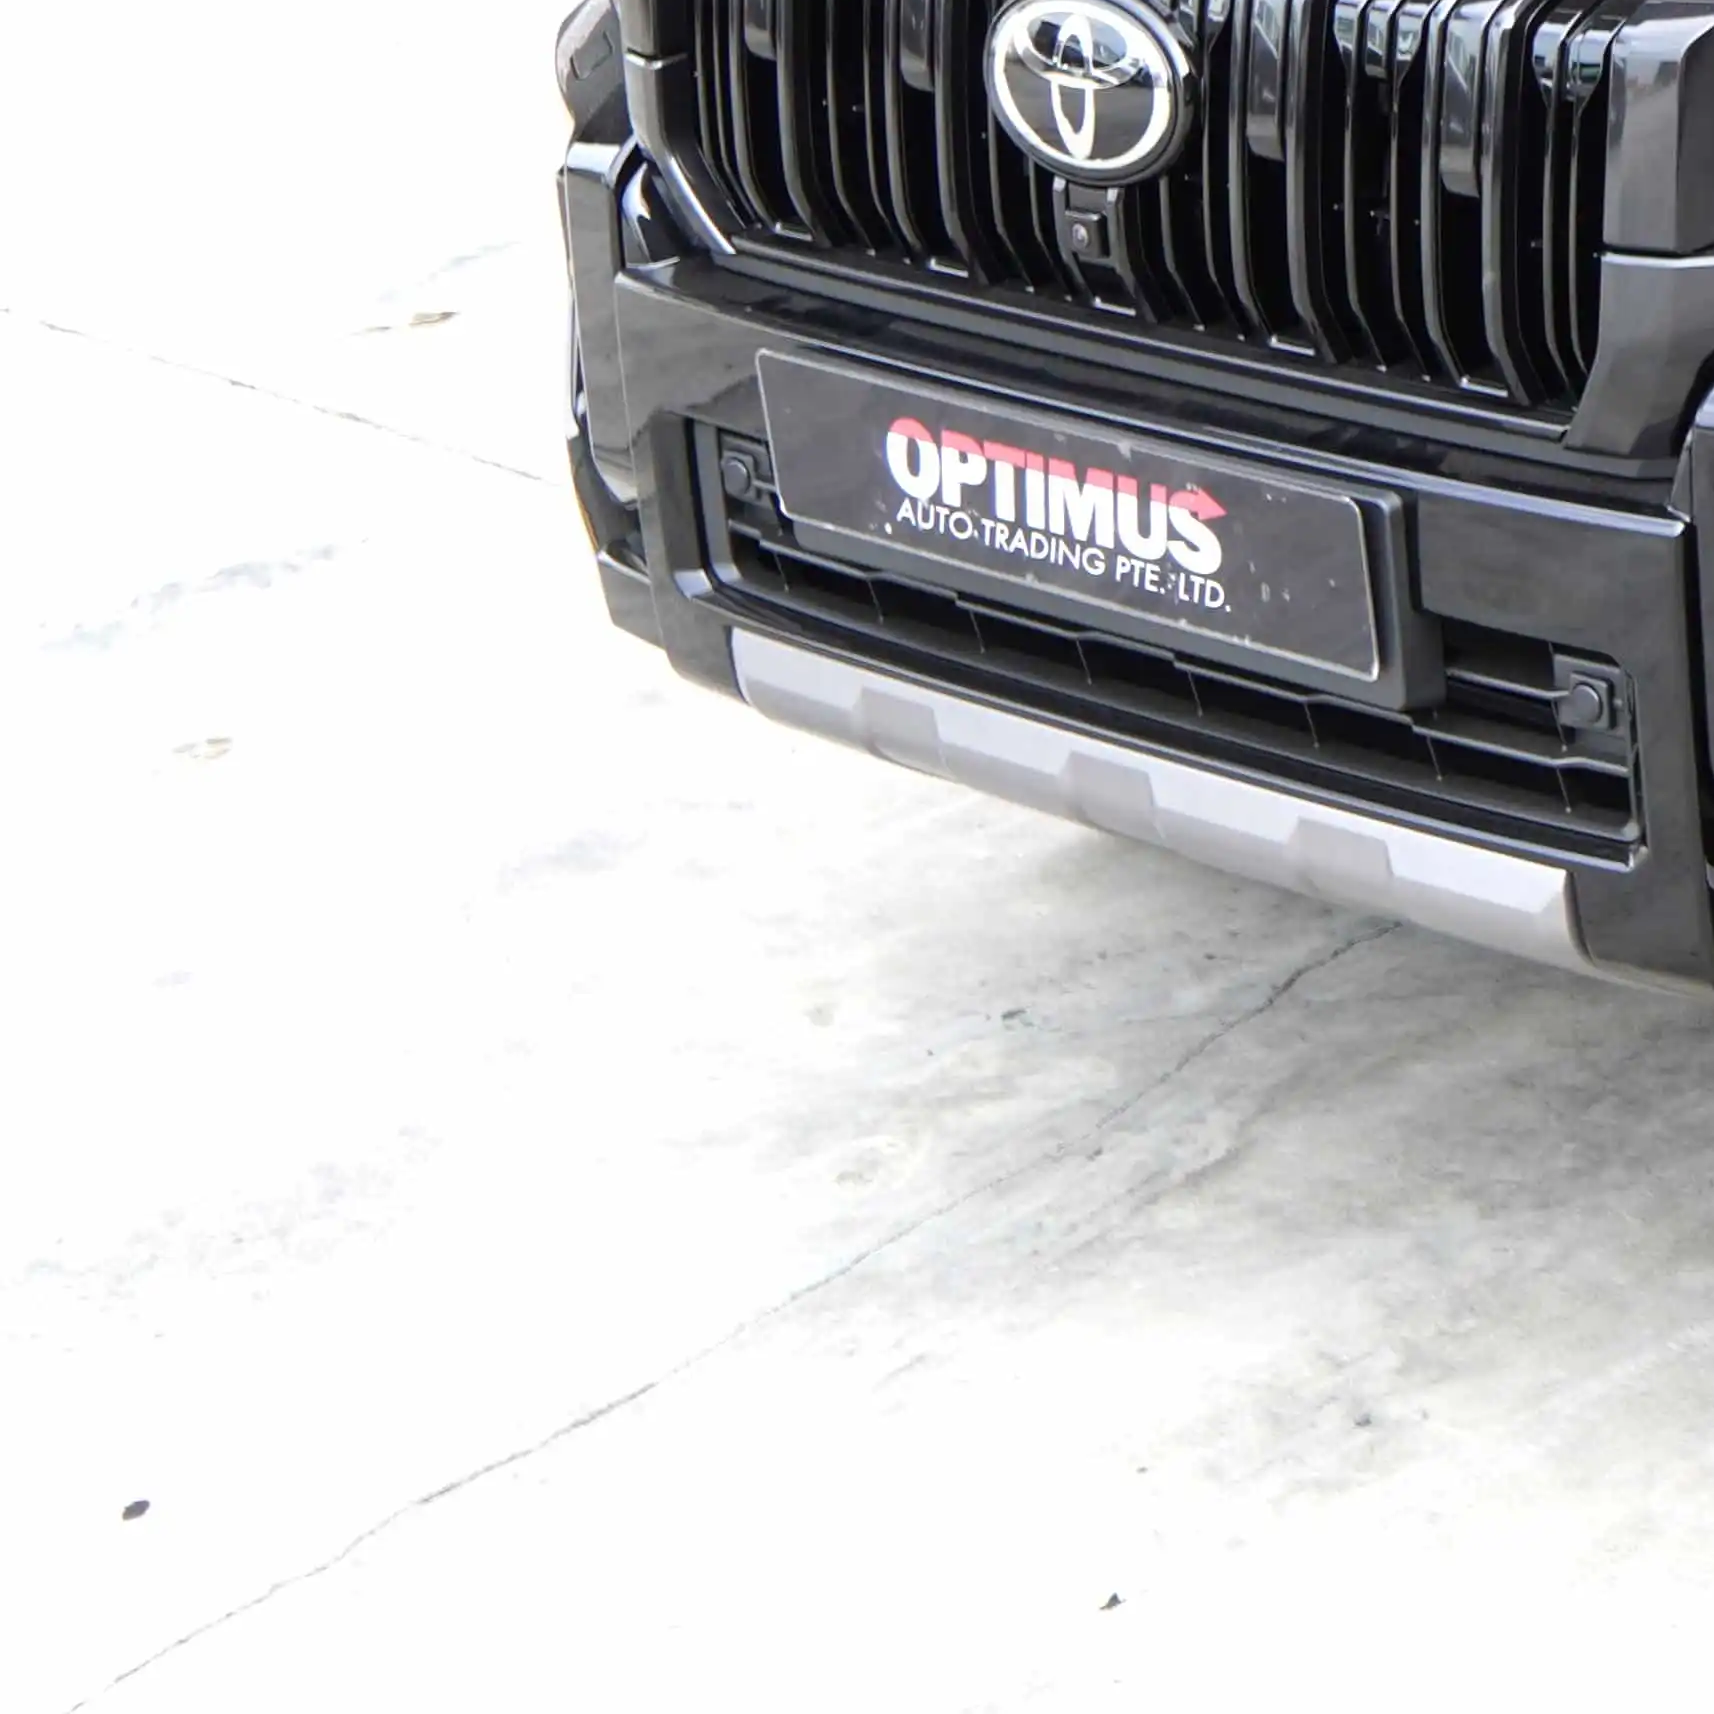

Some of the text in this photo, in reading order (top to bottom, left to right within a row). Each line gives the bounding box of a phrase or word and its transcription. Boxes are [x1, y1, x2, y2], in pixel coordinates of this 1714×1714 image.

[886, 417, 1227, 574] OPTIMUS
[897, 499, 1232, 613] AUTO TRADING PTE. LTD.
